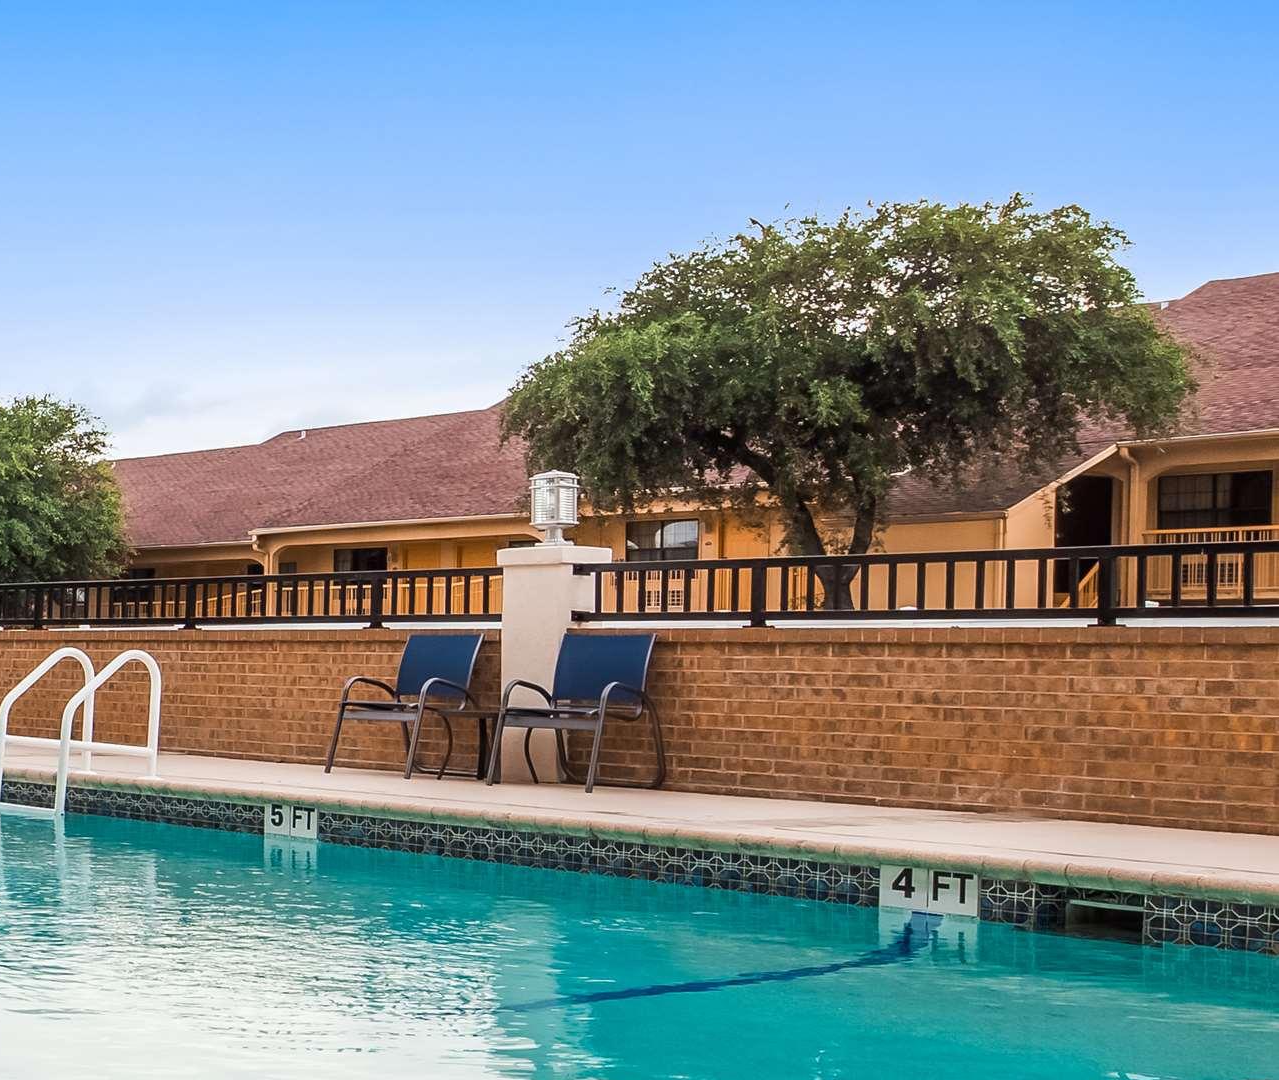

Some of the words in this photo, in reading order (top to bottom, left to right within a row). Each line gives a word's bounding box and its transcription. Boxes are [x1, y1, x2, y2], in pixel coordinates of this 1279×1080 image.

[270, 803, 284, 827] 5
[292, 805, 315, 830] FT
[891, 867, 916, 899] 4
[932, 870, 974, 904] FT
